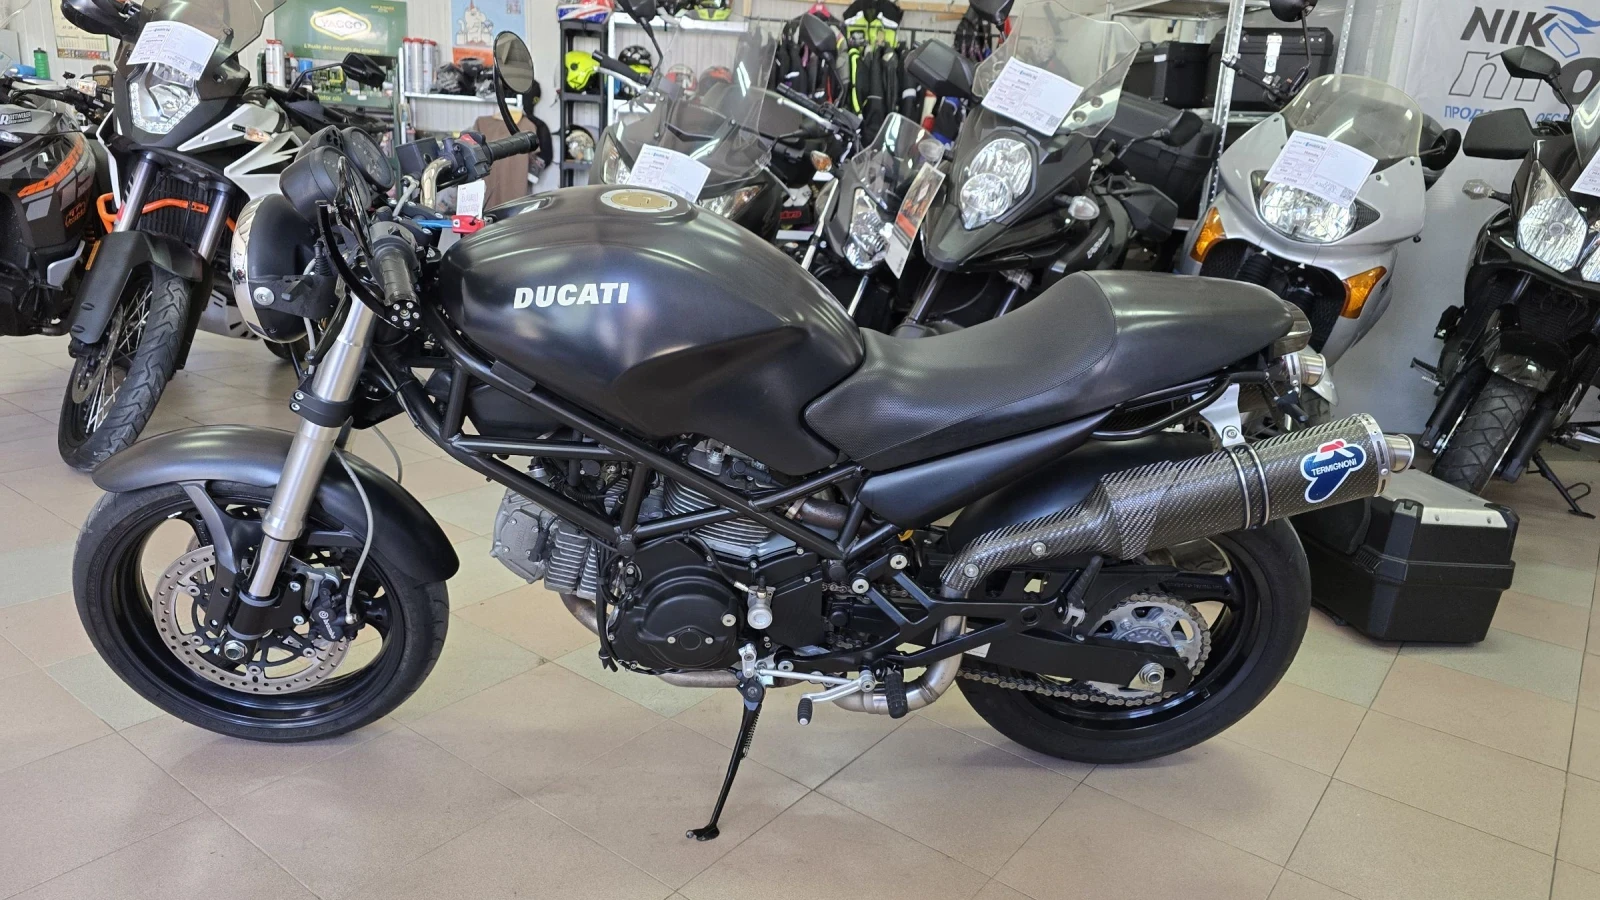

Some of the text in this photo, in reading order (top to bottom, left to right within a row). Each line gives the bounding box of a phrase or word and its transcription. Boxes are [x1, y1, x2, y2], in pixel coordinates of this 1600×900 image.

[321, 18, 364, 30] YACCO
[1460, 6, 1558, 47] NIK
[513, 282, 630, 309] DUCATI
[1311, 458, 1357, 476] TERMIGNONI
